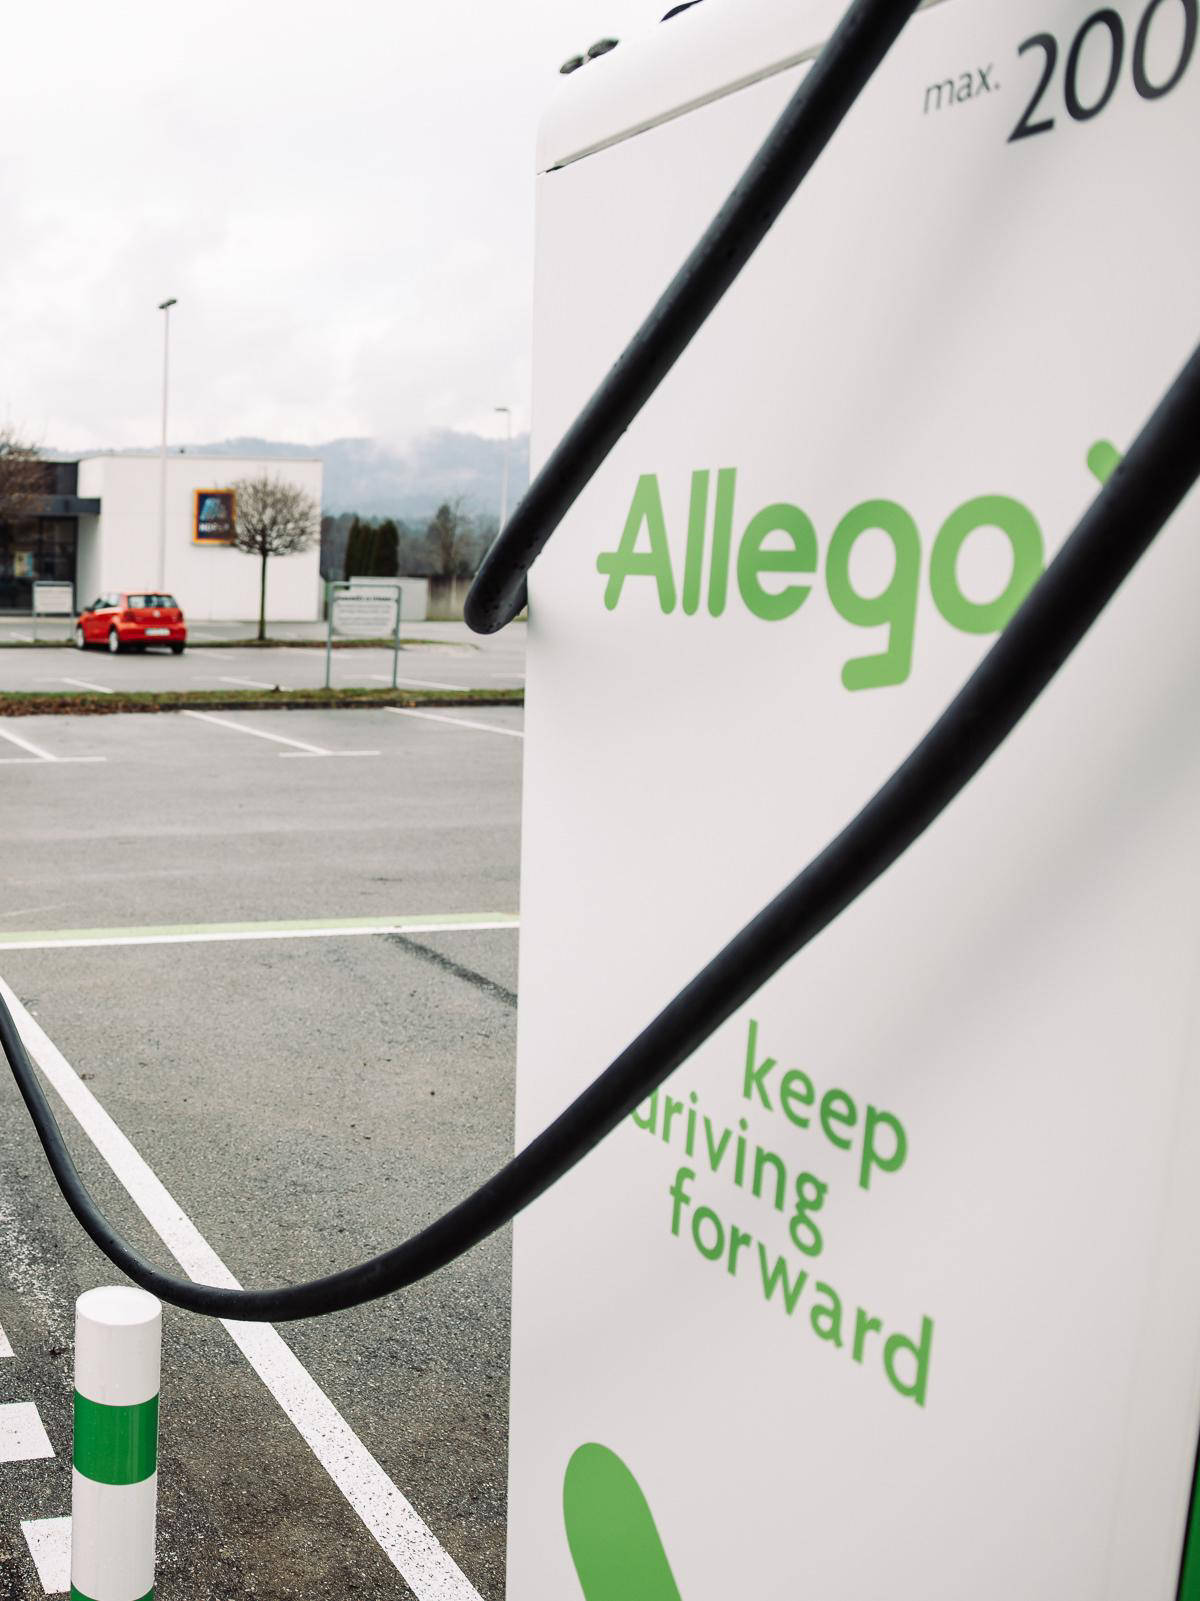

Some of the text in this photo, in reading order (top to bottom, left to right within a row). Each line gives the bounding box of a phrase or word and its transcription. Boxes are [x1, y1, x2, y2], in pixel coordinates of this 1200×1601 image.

[923, 0, 1200, 143] max. 200
[596, 466, 1046, 692] Allego
[743, 1018, 908, 1190] keep
[669, 1166, 934, 1408] forward
